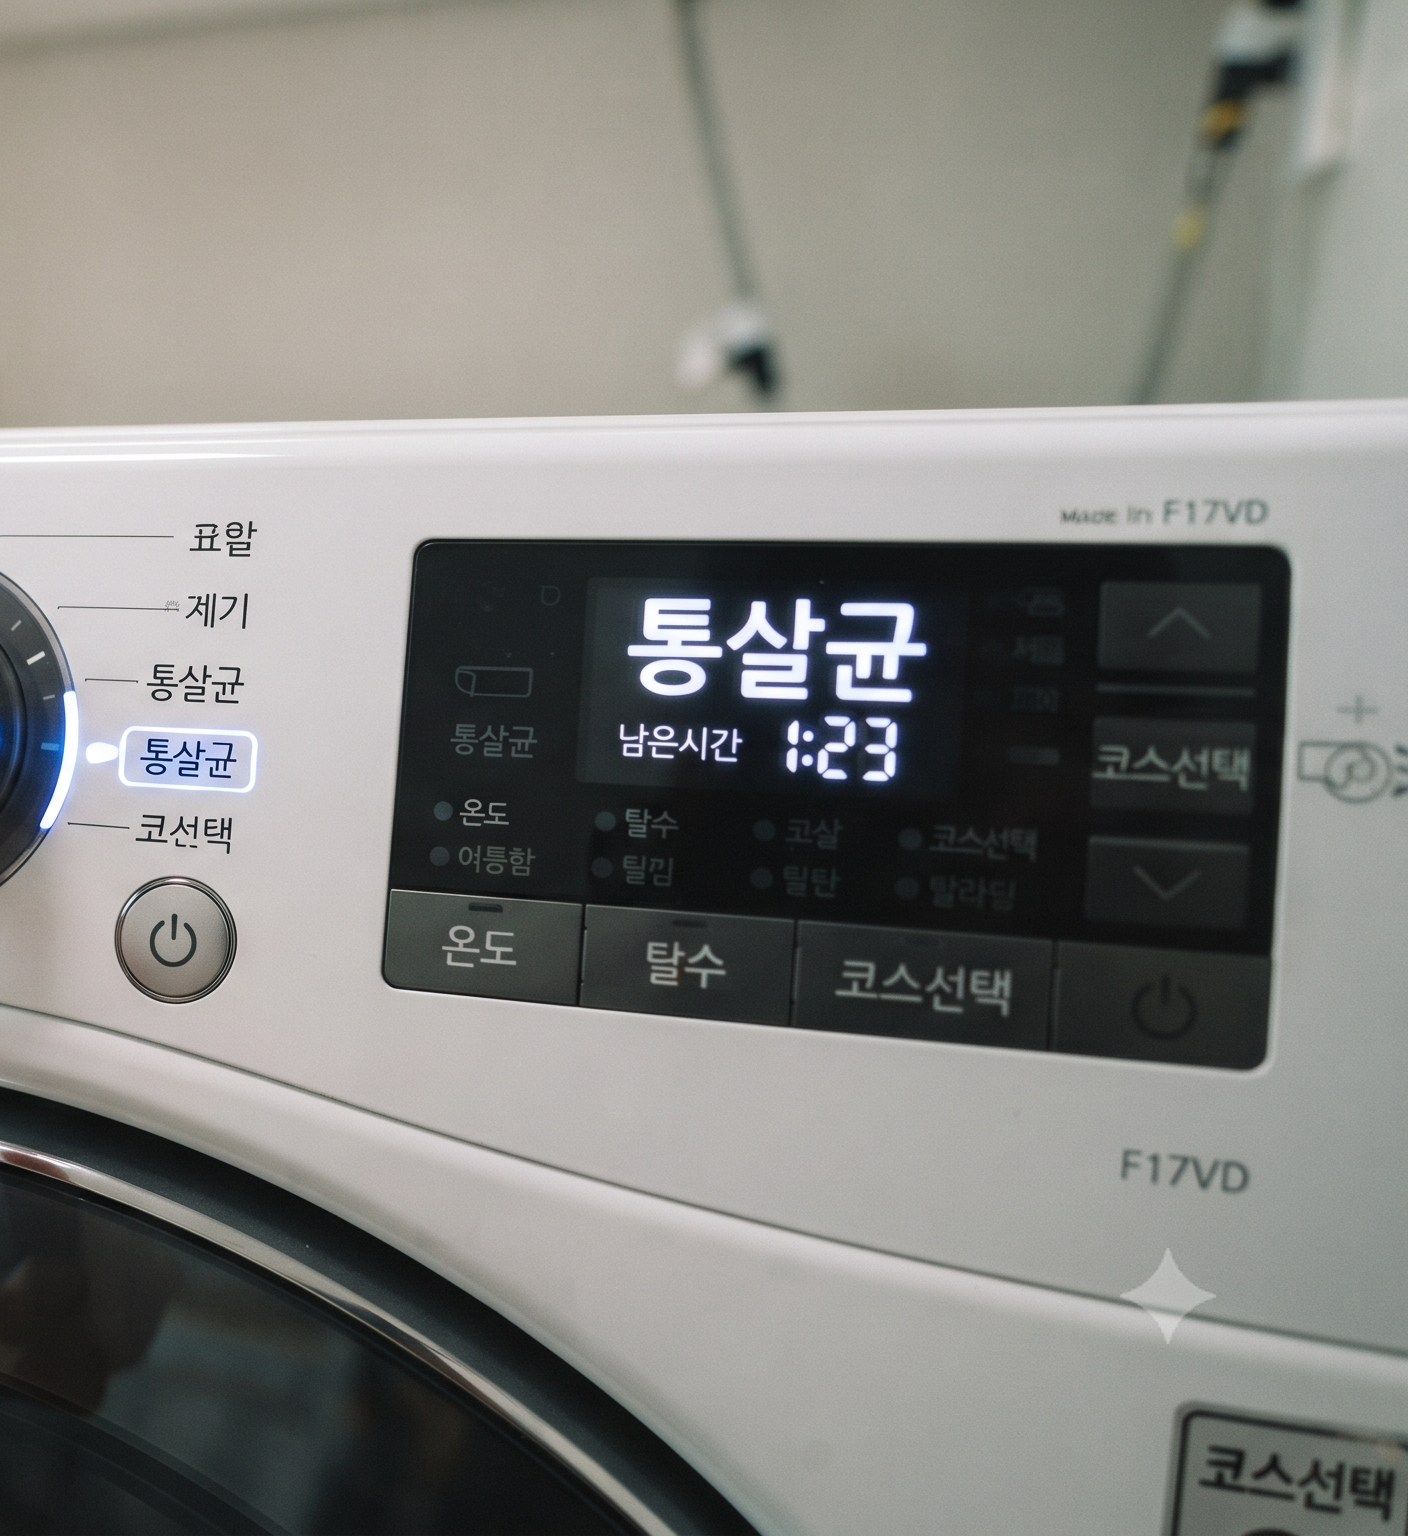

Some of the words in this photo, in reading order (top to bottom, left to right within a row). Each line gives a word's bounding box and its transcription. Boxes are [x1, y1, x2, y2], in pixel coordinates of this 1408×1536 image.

[1162, 498, 1272, 526] F17VD
[626, 597, 928, 703] 통살균
[146, 663, 245, 705] 통살균
[139, 737, 237, 780] 통살균
[449, 722, 538, 759] 통살균
[618, 722, 743, 763] 남은시간
[785, 715, 899, 783] 1:23
[1093, 744, 1251, 791] 코스선택
[134, 813, 233, 855] 코선택
[459, 798, 510, 828] 온도
[624, 807, 678, 839] 탈수
[929, 824, 1038, 862] 코스선택
[441, 924, 517, 969] 온도
[646, 941, 727, 989] 탈수
[834, 959, 1012, 1017] 코스선택
[1120, 1148, 1252, 1195] F17VD
[1198, 1443, 1397, 1523] 코스선택
